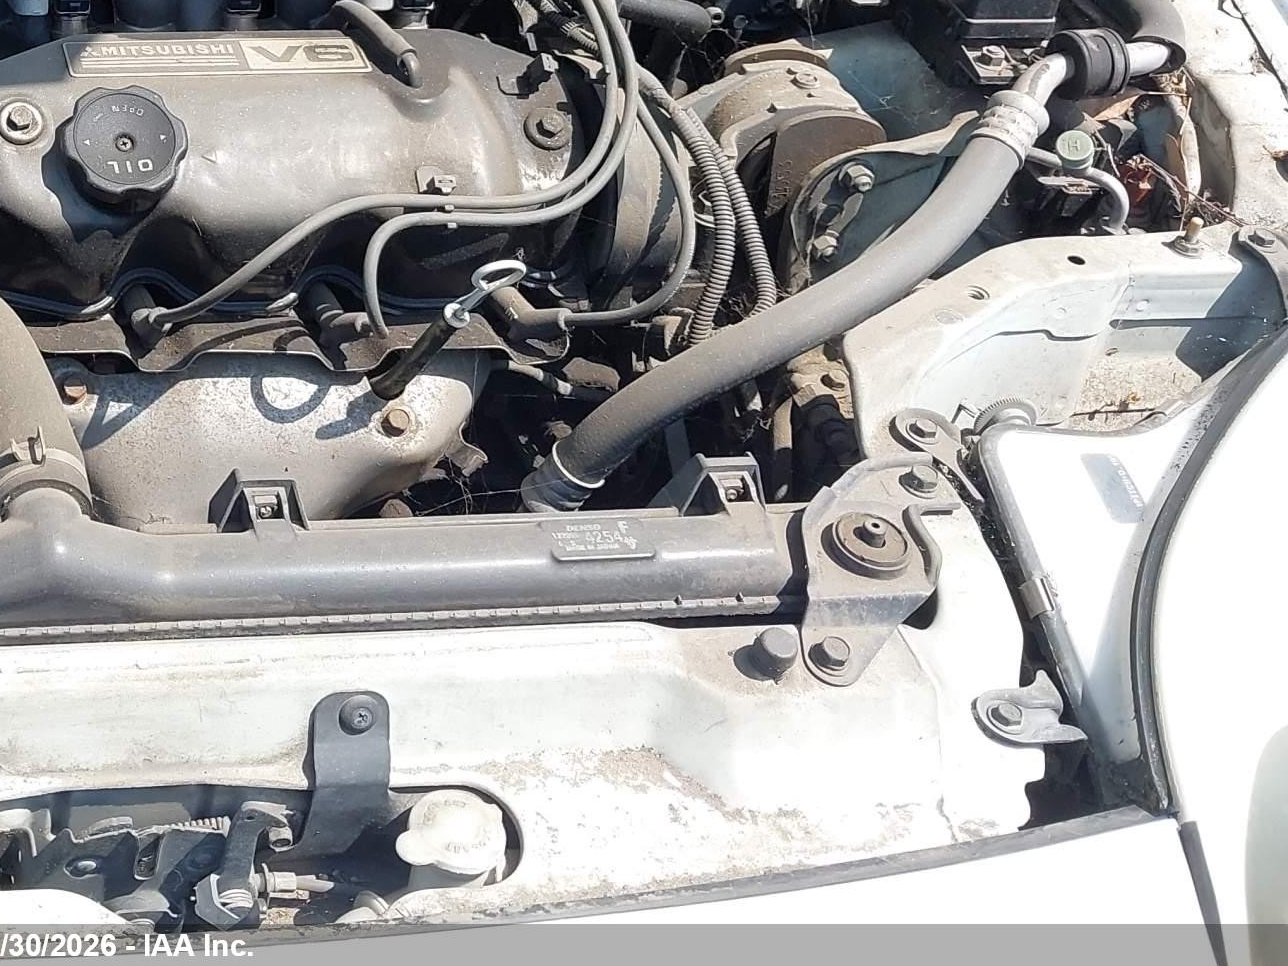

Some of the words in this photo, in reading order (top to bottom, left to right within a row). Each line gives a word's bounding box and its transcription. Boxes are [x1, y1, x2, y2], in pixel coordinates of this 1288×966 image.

[101, 42, 234, 58] MITSUBISHI
[248, 43, 357, 64] V6
[110, 103, 146, 117] OPEN
[106, 157, 155, 174] OIL
